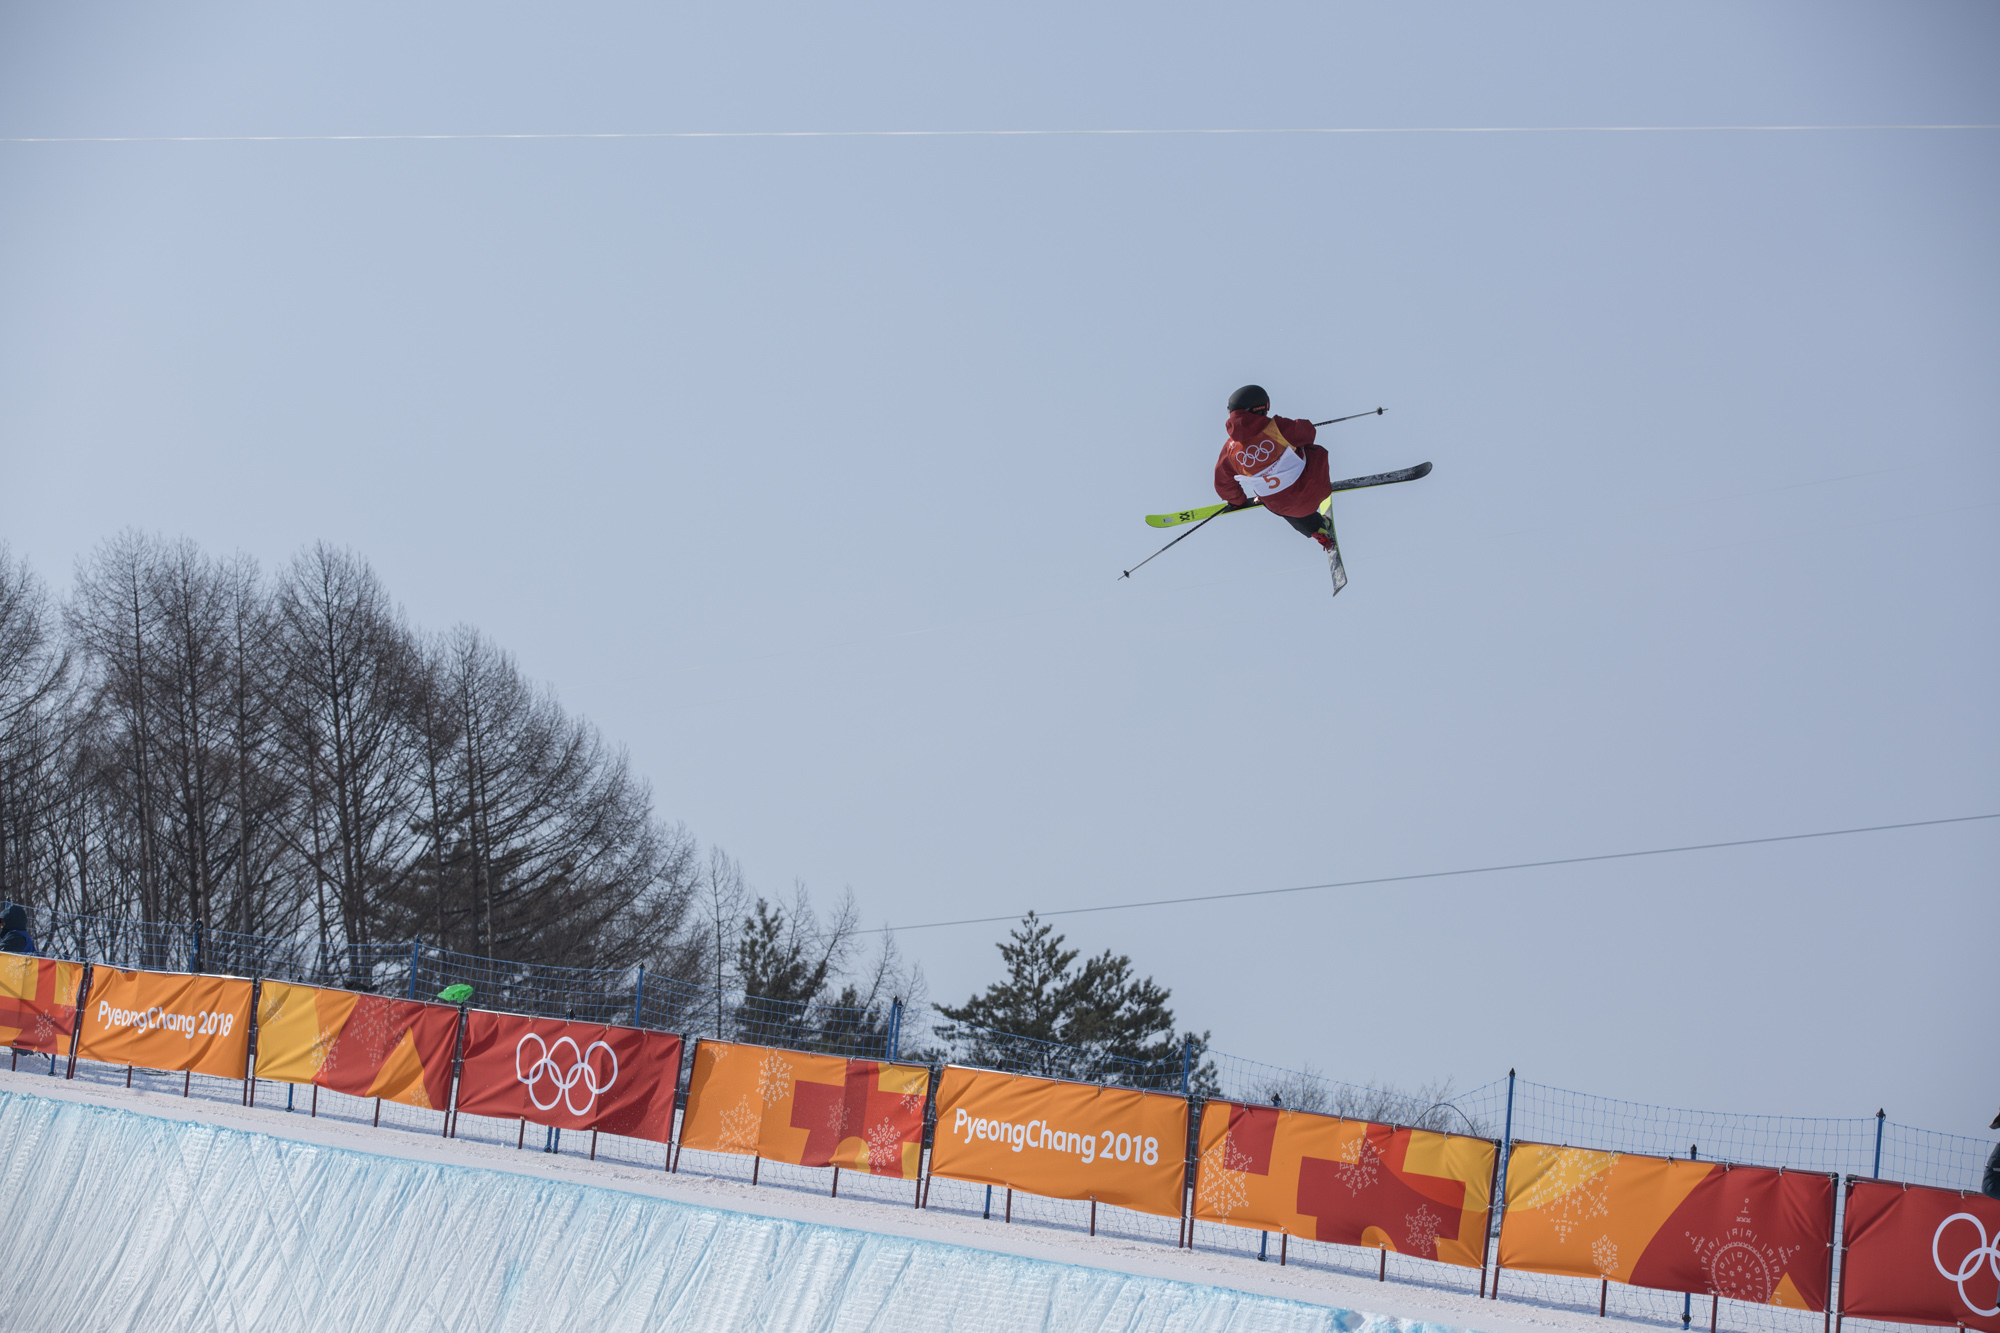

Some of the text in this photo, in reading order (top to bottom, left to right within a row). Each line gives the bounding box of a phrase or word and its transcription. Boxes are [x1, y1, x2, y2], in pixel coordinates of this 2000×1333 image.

[1262, 475, 1280, 489] 5
[97, 999, 234, 1040] PyeongChang 2018
[953, 1107, 1159, 1166] PyeongChang 2018
